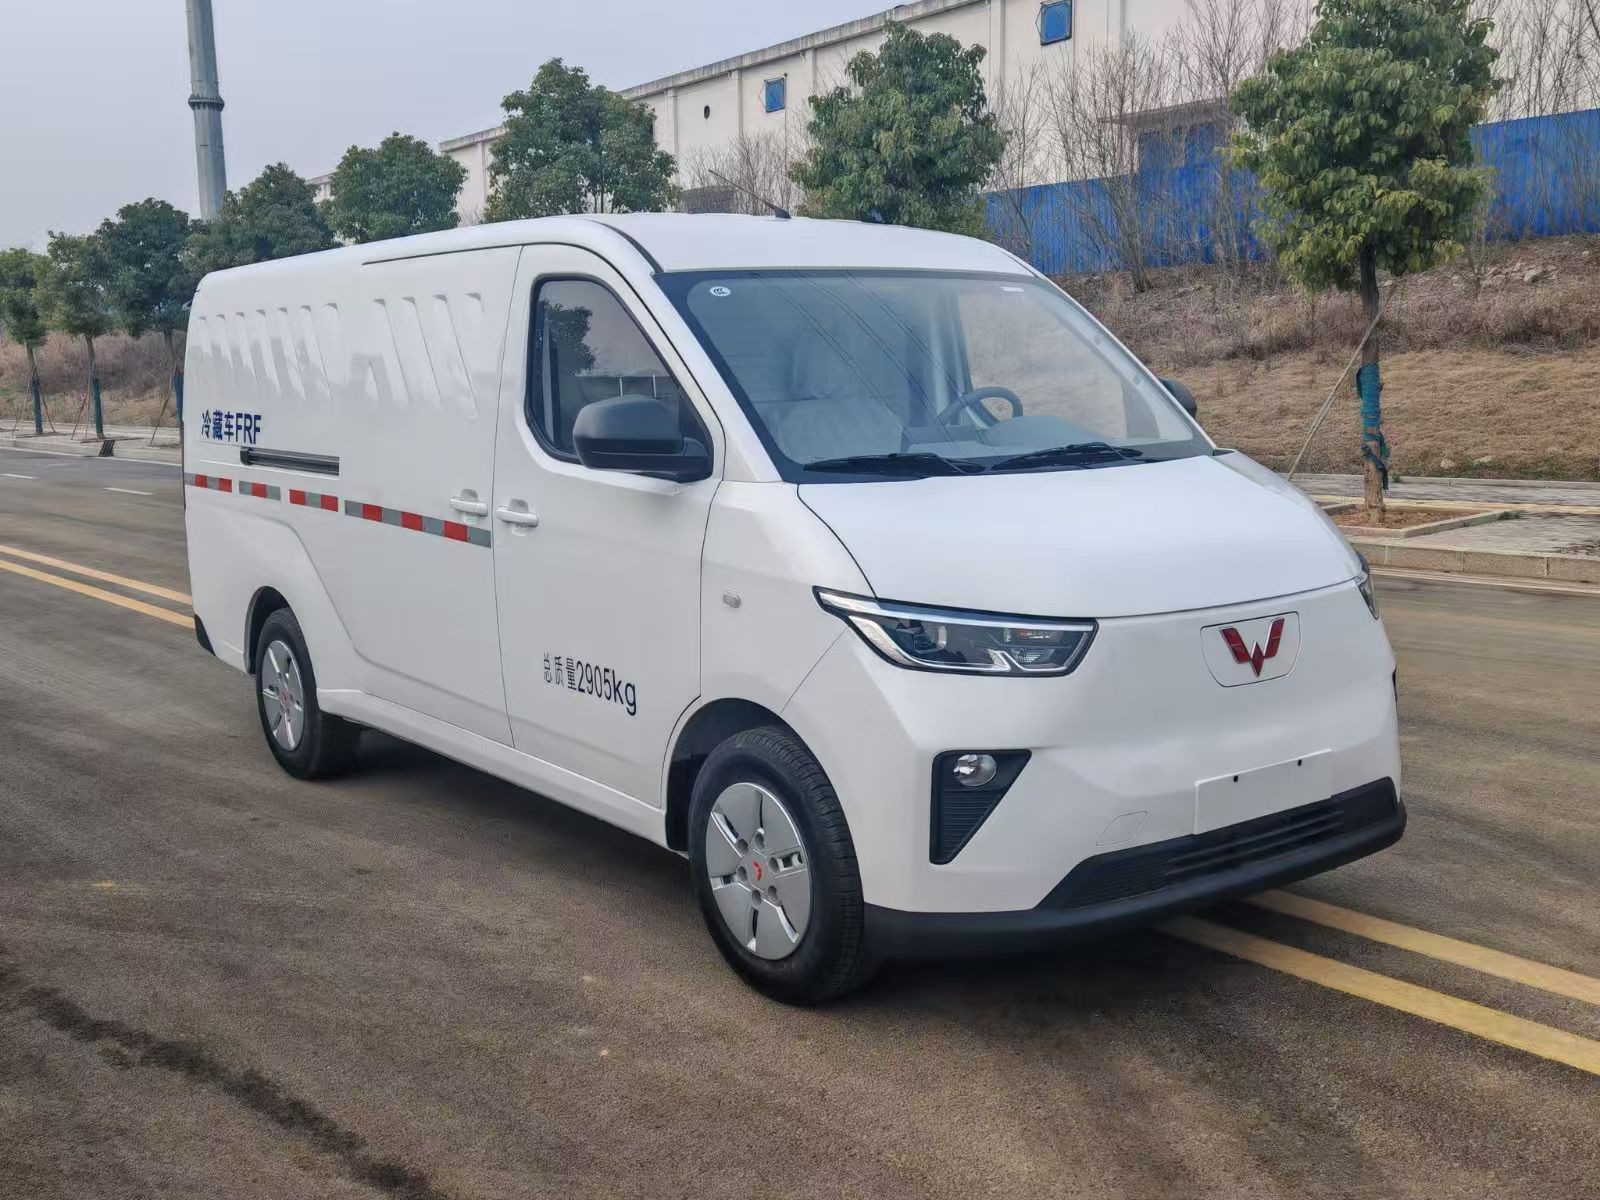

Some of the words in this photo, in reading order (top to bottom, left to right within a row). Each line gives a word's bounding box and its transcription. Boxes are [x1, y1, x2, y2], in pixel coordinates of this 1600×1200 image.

[201, 409, 262, 445] 冷藏车FRF
[543, 652, 637, 716] 总质量2905kg
